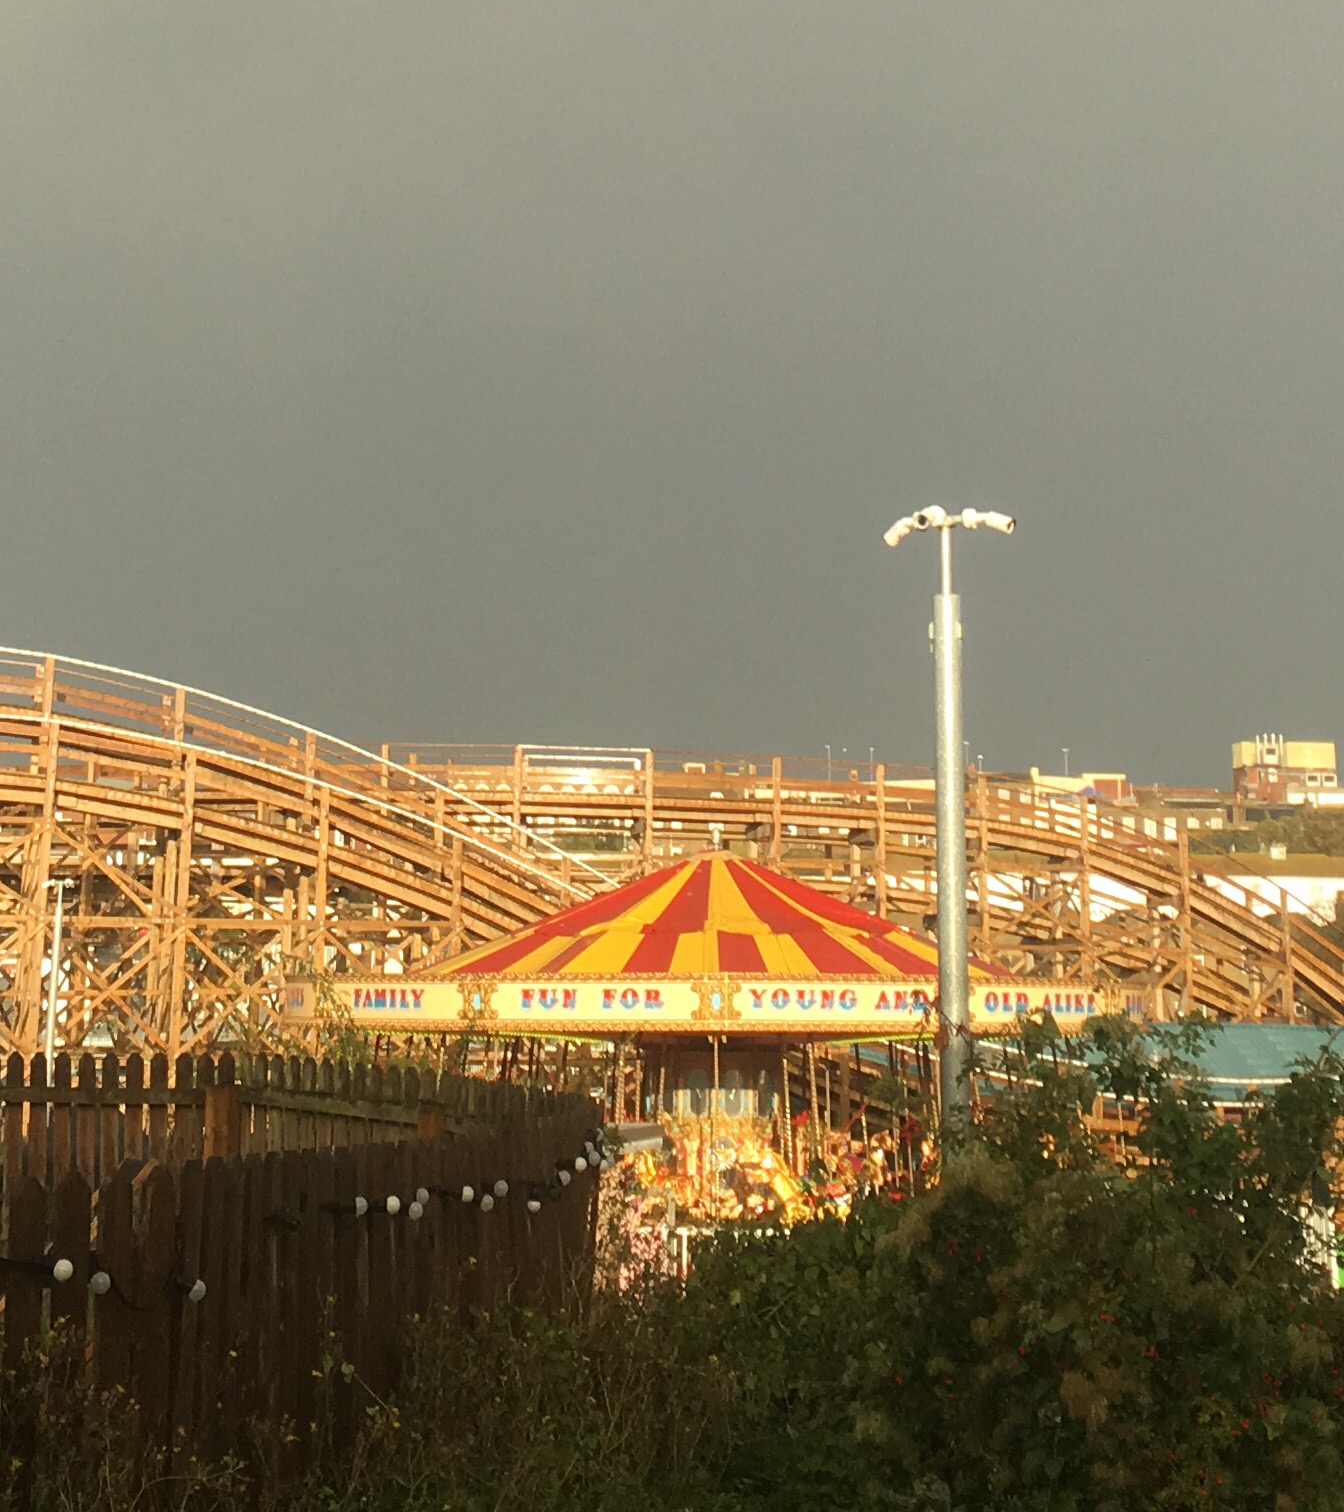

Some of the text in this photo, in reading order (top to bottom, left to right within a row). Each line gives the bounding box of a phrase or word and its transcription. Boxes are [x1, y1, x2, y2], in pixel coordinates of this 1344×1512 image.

[353, 987, 1095, 1014] FAMILY FUN FOR YOUNG AND OLD ALIKE
